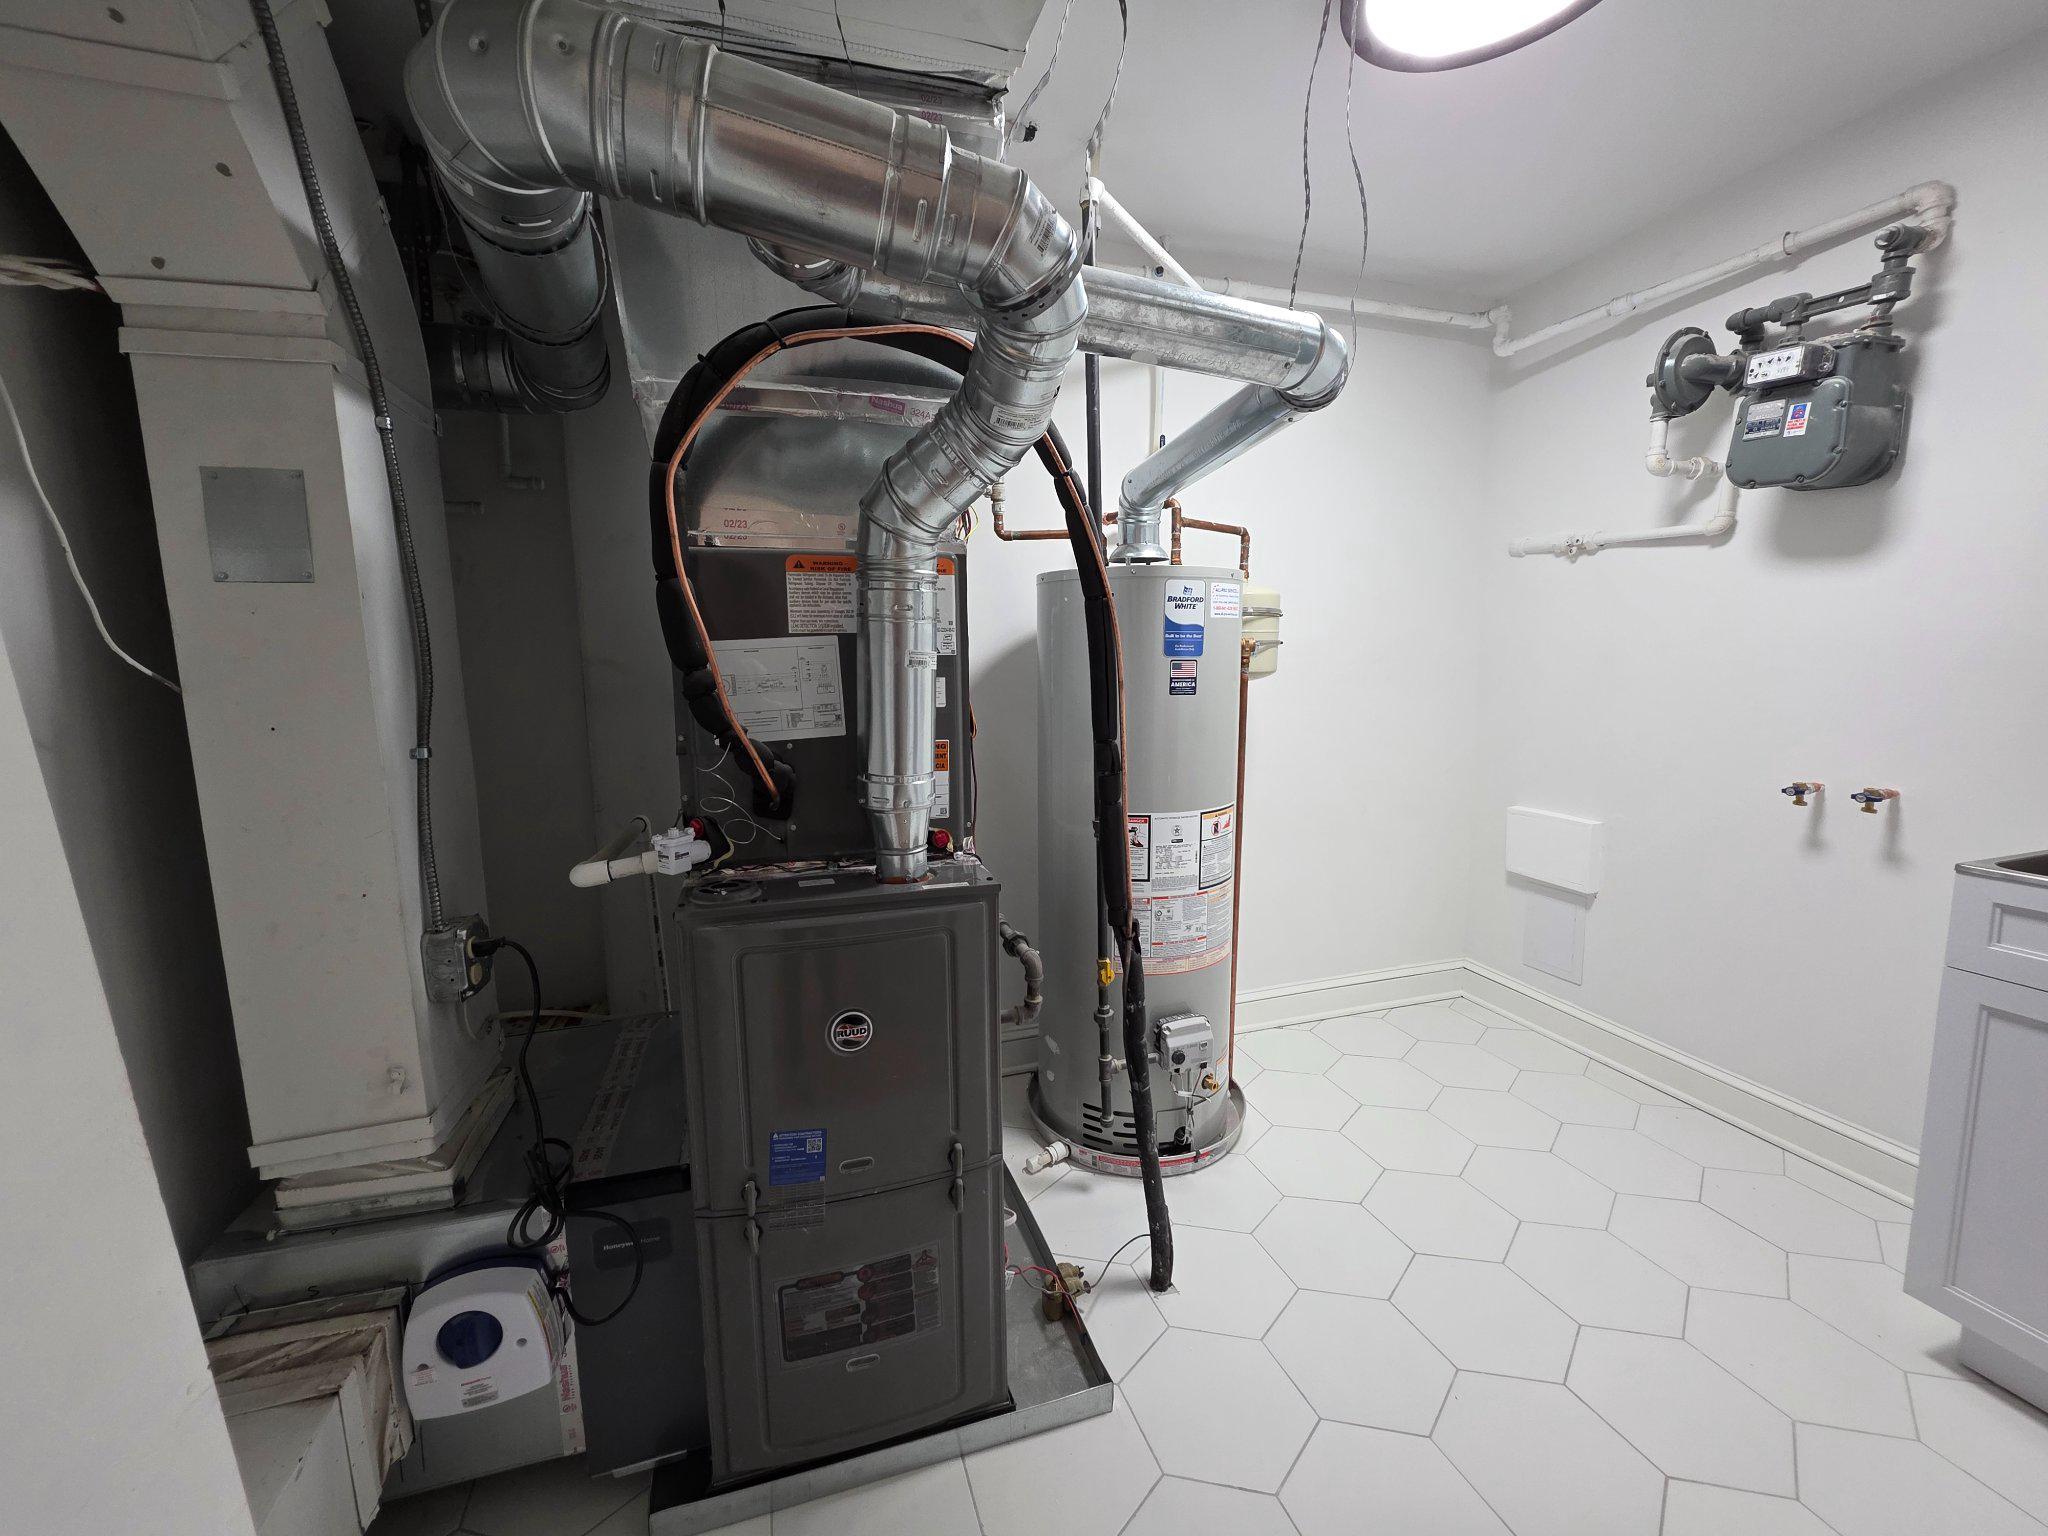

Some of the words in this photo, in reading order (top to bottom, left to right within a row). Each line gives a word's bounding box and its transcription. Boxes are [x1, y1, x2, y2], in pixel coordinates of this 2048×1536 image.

[871, 396, 903, 411] Nashua
[723, 519, 748, 529] 02/23
[837, 1027, 867, 1038] RUUD
